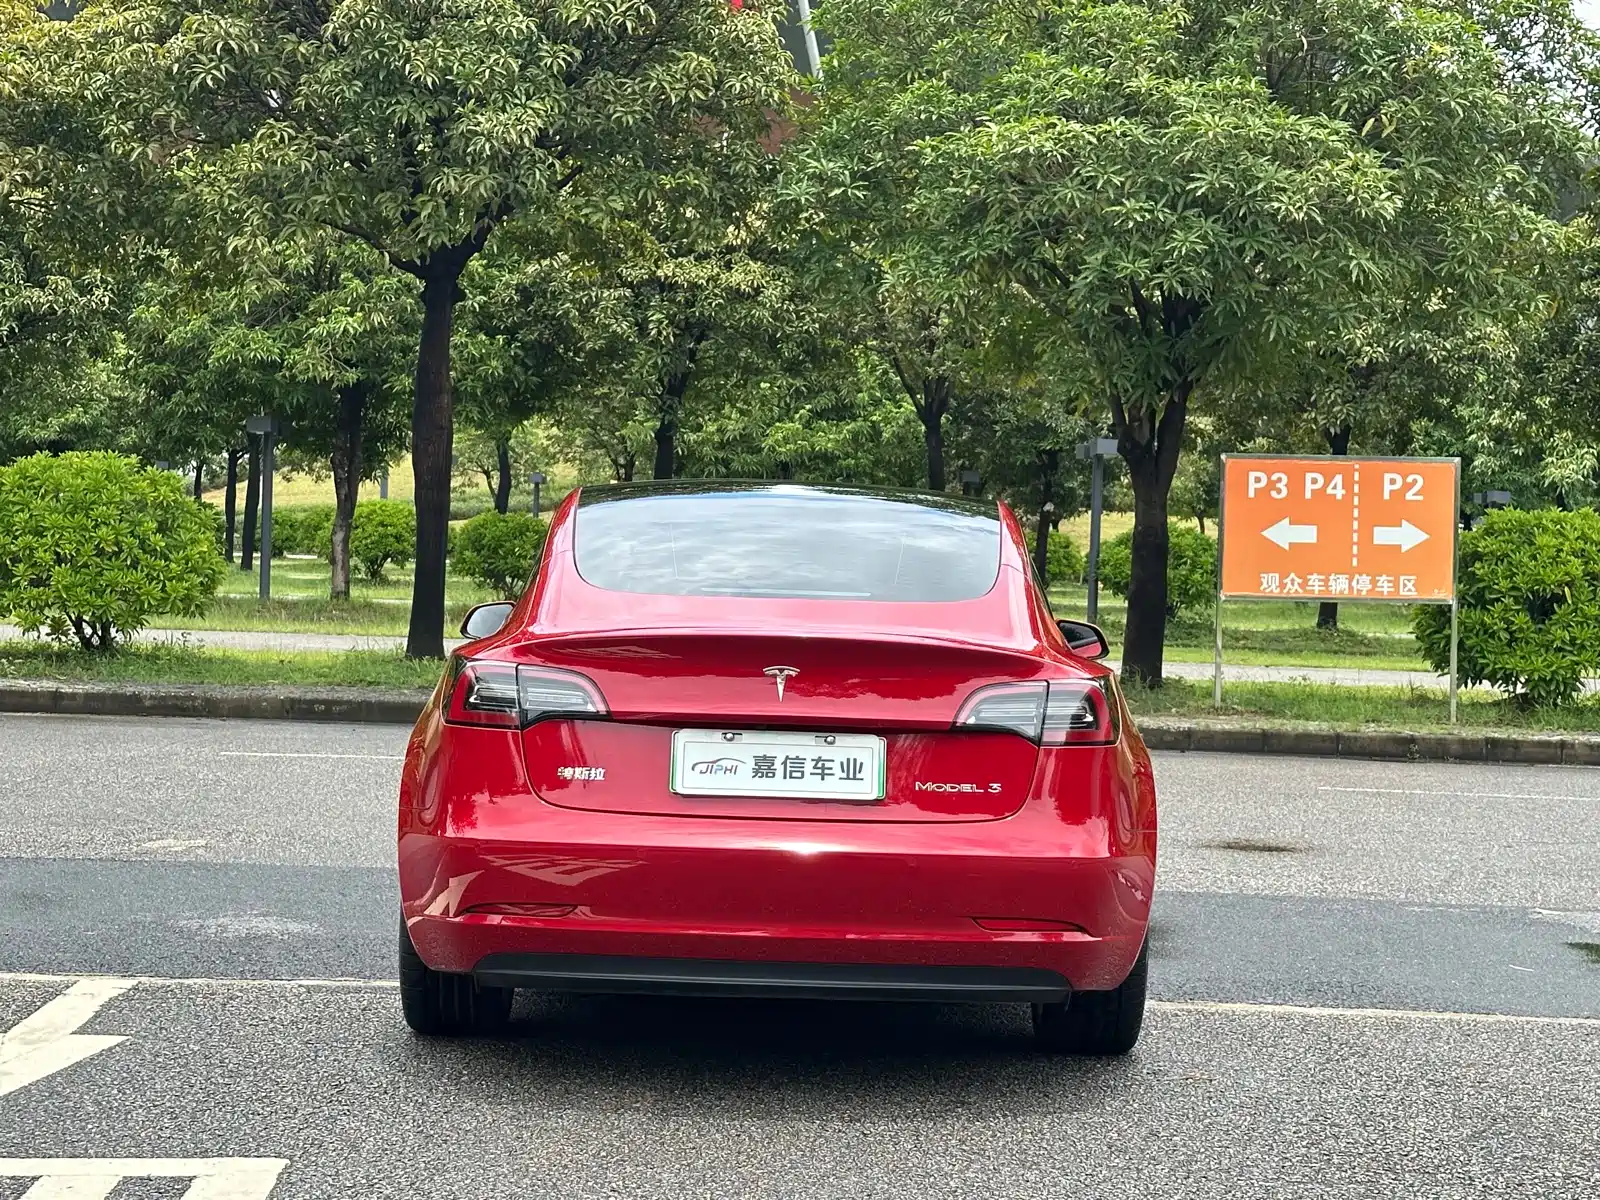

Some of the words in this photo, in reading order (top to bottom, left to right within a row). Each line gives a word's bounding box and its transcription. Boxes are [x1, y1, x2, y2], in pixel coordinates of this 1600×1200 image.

[1247, 471, 1289, 500] P3
[1304, 472, 1347, 500] P4
[1382, 472, 1425, 501] P2
[1259, 572, 1418, 597] 观众车辆停车区
[751, 754, 865, 781] 嘉信车业
[915, 781, 985, 793] MODEL
[987, 783, 1002, 793] 3
